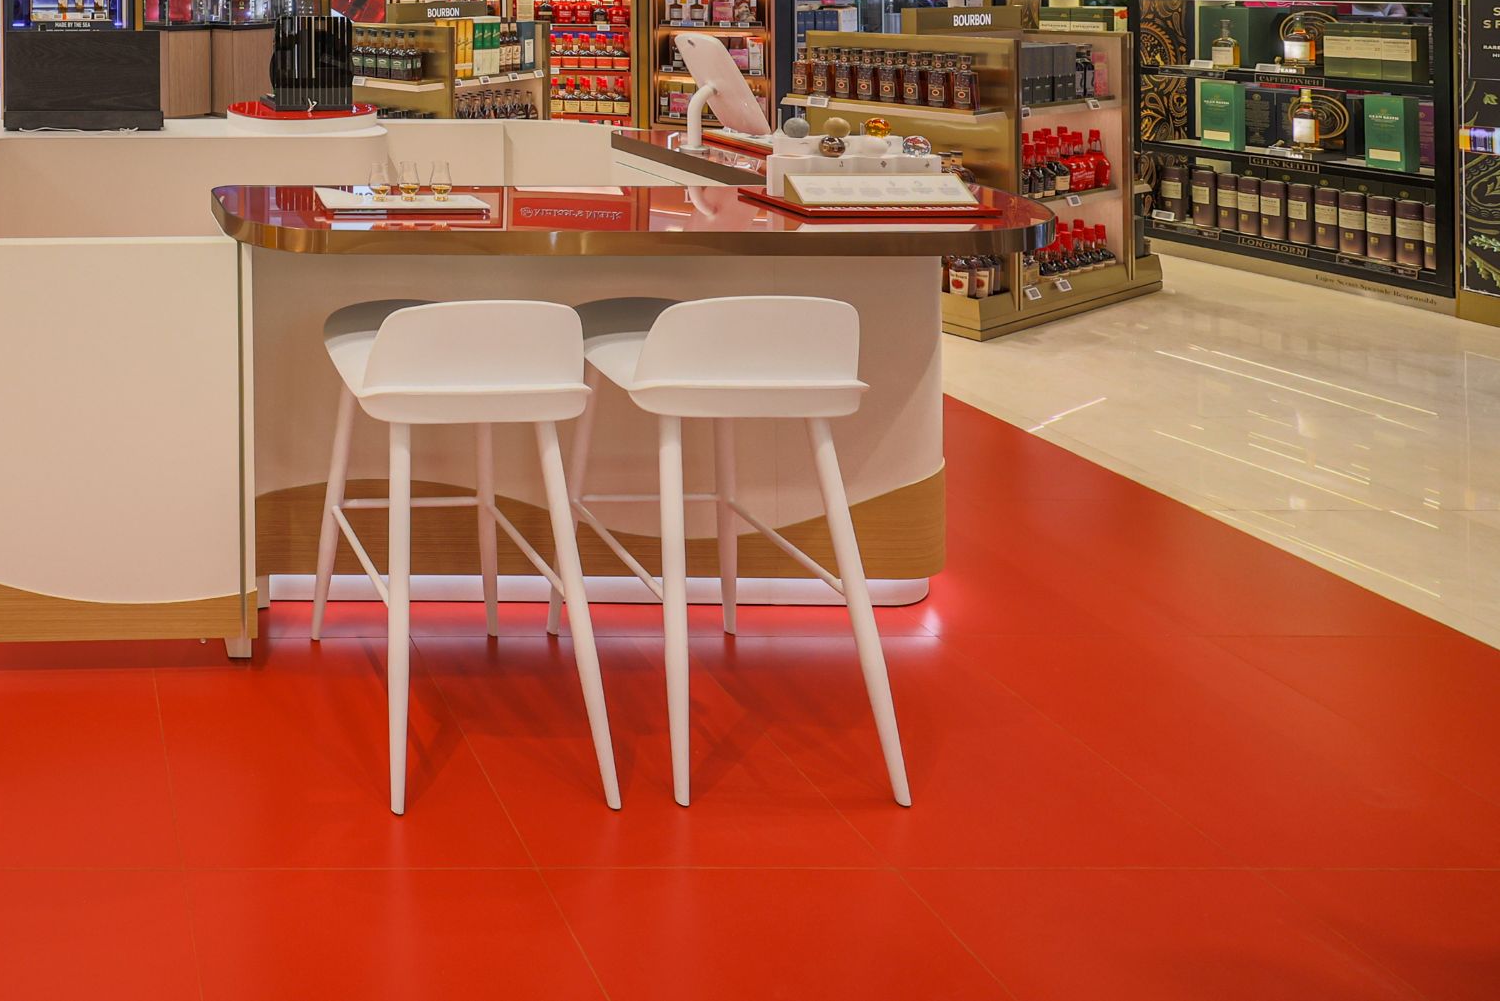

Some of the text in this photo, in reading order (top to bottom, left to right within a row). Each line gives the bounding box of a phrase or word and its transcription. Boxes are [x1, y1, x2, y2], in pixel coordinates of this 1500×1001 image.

[427, 7, 460, 17] BOURBON
[953, 13, 992, 27] BOURBON
[1259, 76, 1320, 85] CAPERDONICH
[1252, 157, 1317, 172] GLEN KEITH
[1241, 237, 1305, 256] LONGMORN
